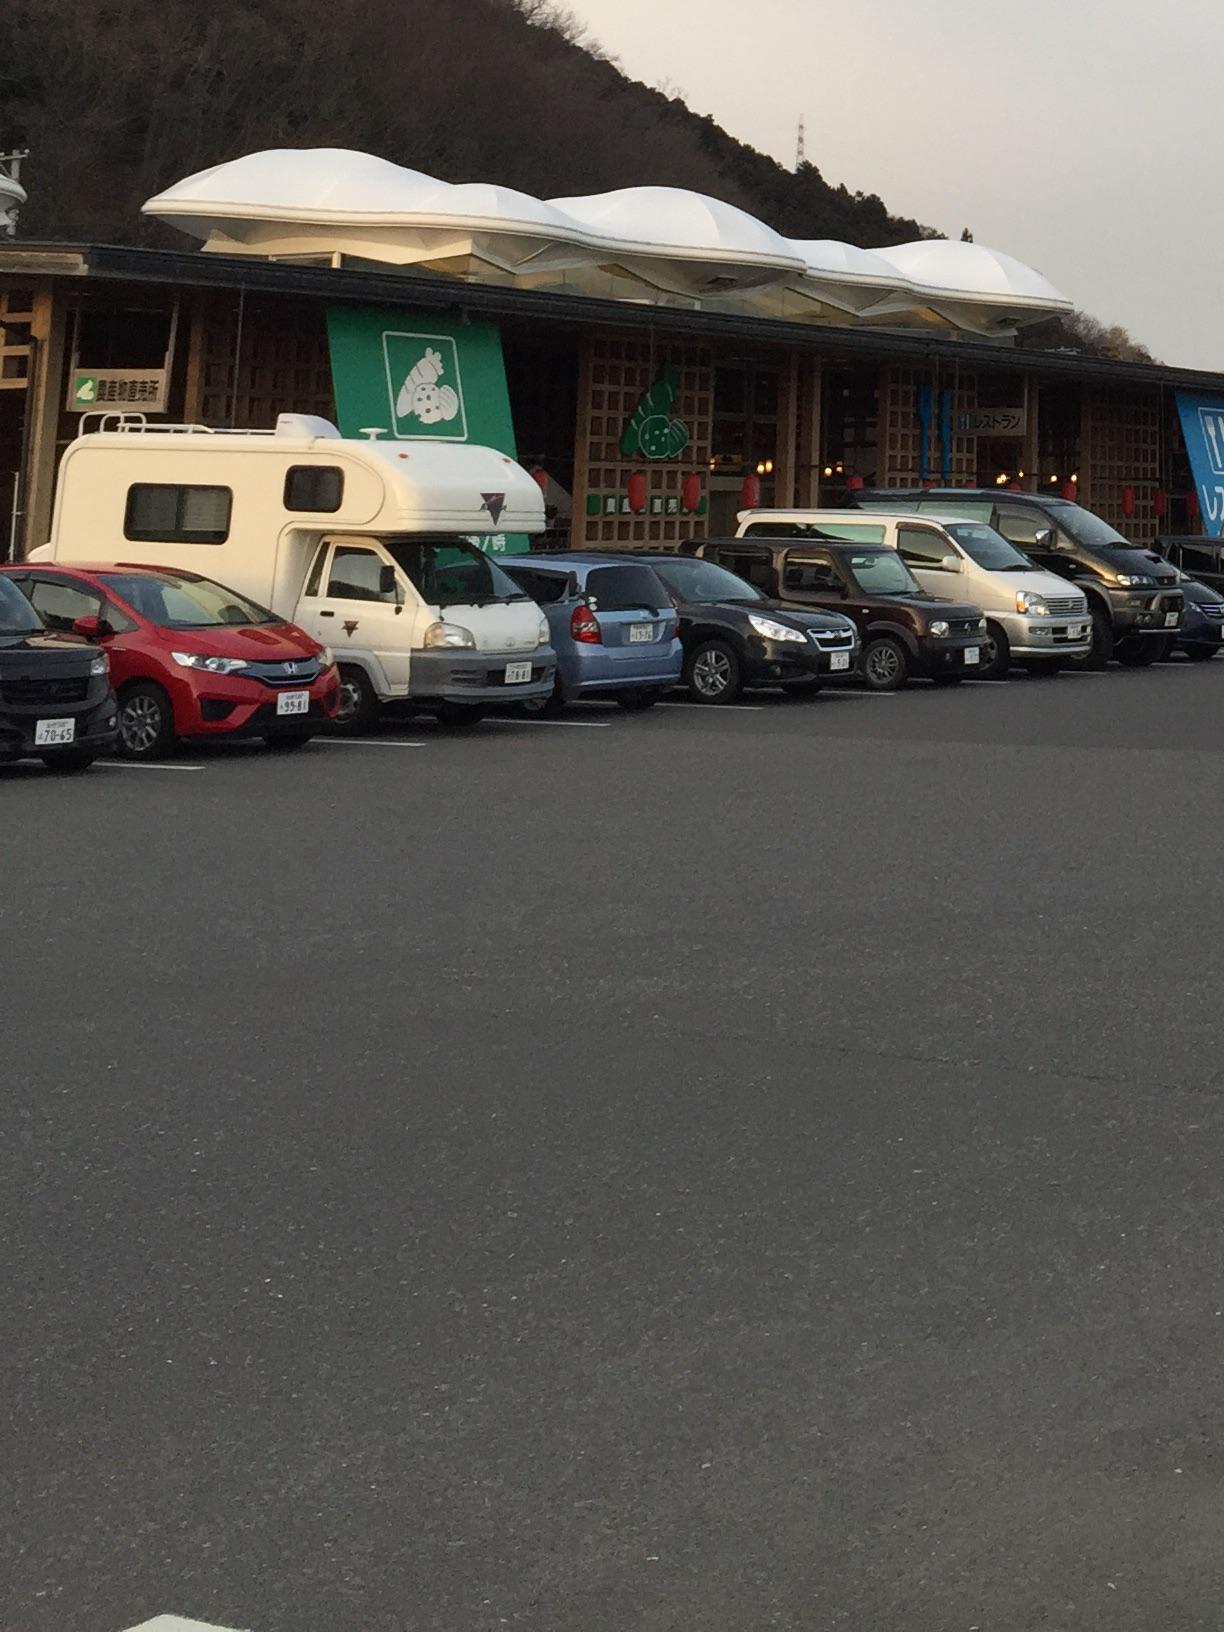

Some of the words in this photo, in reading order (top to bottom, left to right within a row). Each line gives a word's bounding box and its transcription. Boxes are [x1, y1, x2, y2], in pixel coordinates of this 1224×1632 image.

[975, 414, 1021, 430] レストラン
